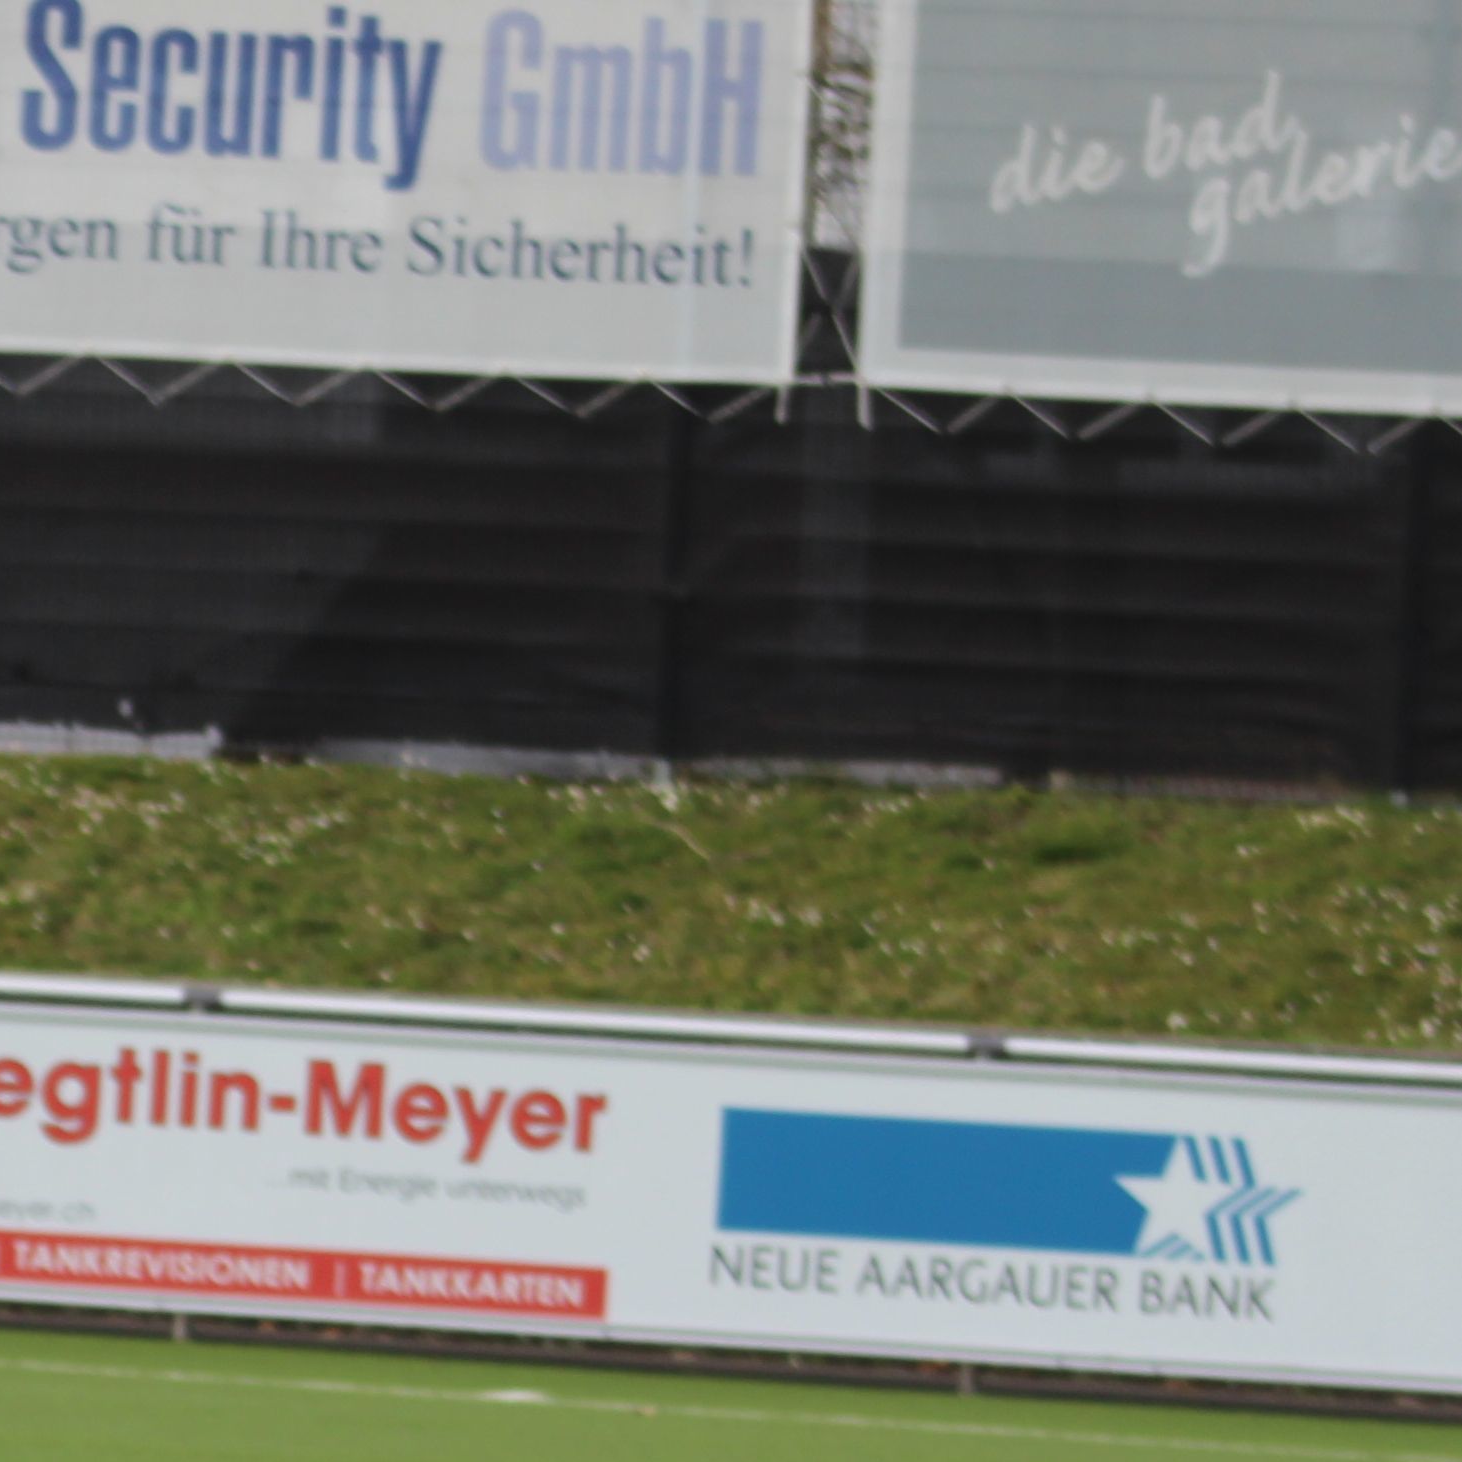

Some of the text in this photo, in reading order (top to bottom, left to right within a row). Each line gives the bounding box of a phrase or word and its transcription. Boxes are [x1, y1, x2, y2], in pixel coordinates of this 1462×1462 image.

[20, 0, 443, 192] Security
[479, 8, 764, 178] GmbH
[991, 68, 1307, 213] die bad
[146, 204, 234, 270] für
[259, 208, 383, 276] Ihre
[407, 215, 755, 290] Sicherheit!
[1183, 114, 1462, 277] galerie
[14, 1241, 311, 1290] TANKREVISIONEN
[360, 1263, 584, 1306] TANKKARTEN
[710, 1244, 1275, 1323] NEUE AARGAUER BANK
